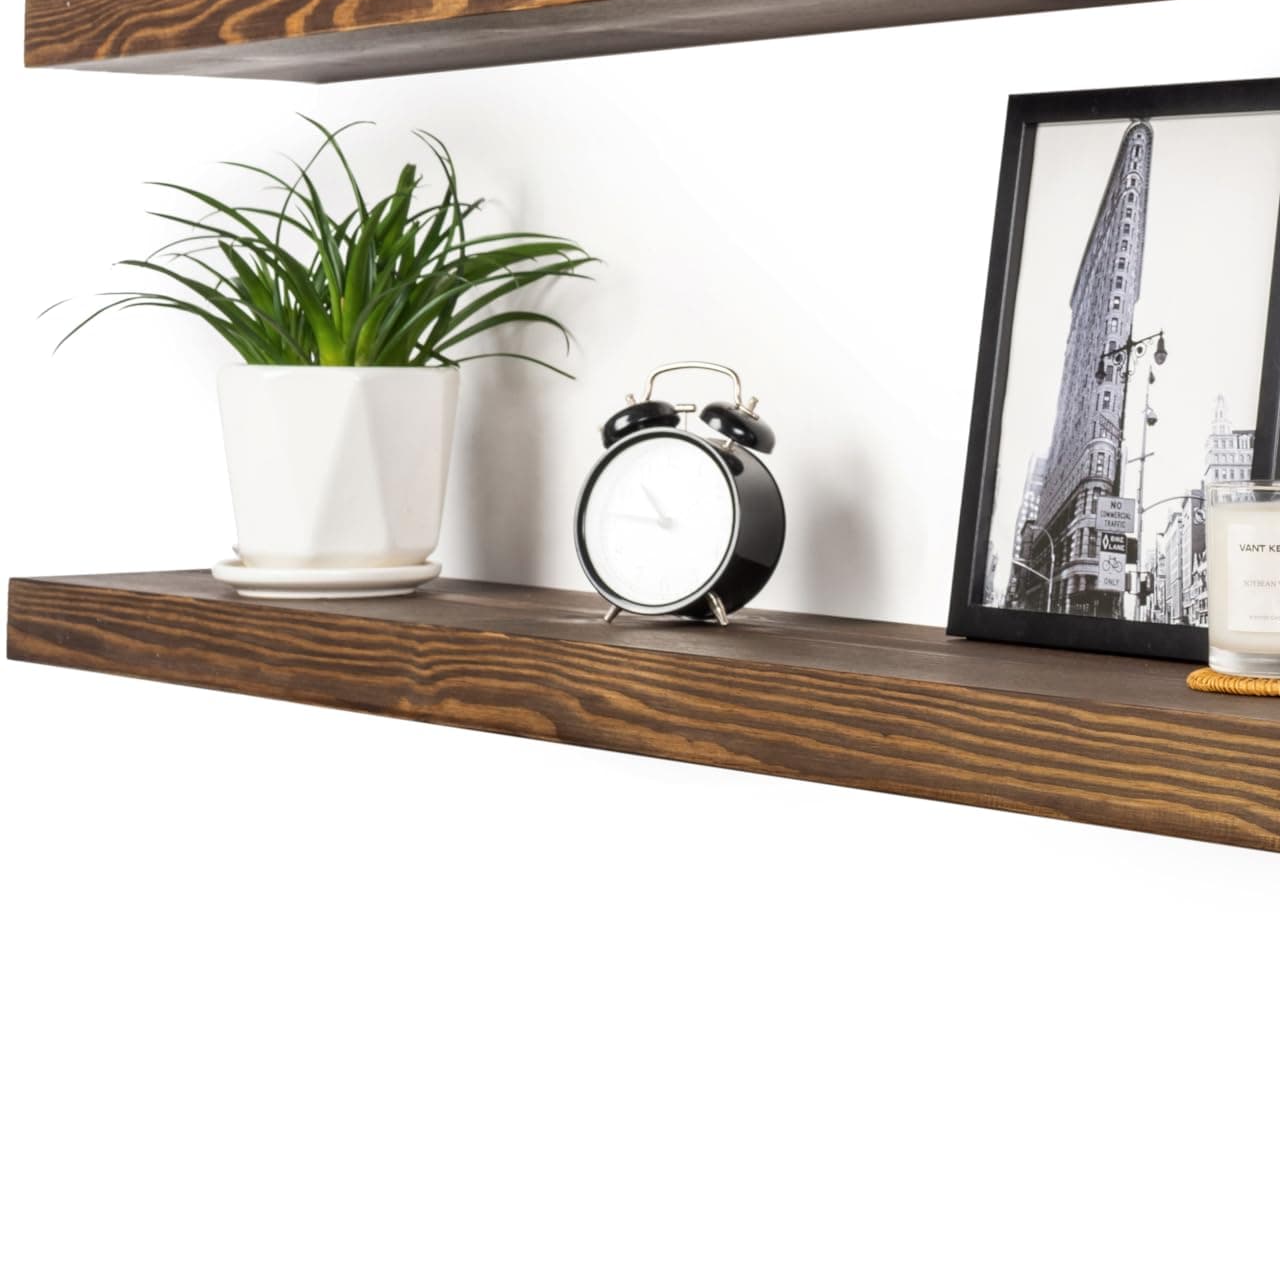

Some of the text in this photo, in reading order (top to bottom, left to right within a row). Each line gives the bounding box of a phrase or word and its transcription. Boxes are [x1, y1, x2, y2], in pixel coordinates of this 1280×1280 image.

[1110, 500, 1122, 510] NO
[1100, 511, 1131, 520] COMMERCIAL
[1104, 520, 1126, 529] TRAFFIC
[1108, 543, 1126, 552] LANE
[1239, 544, 1266, 553] VANT
[1104, 577, 1119, 586] ONLY
